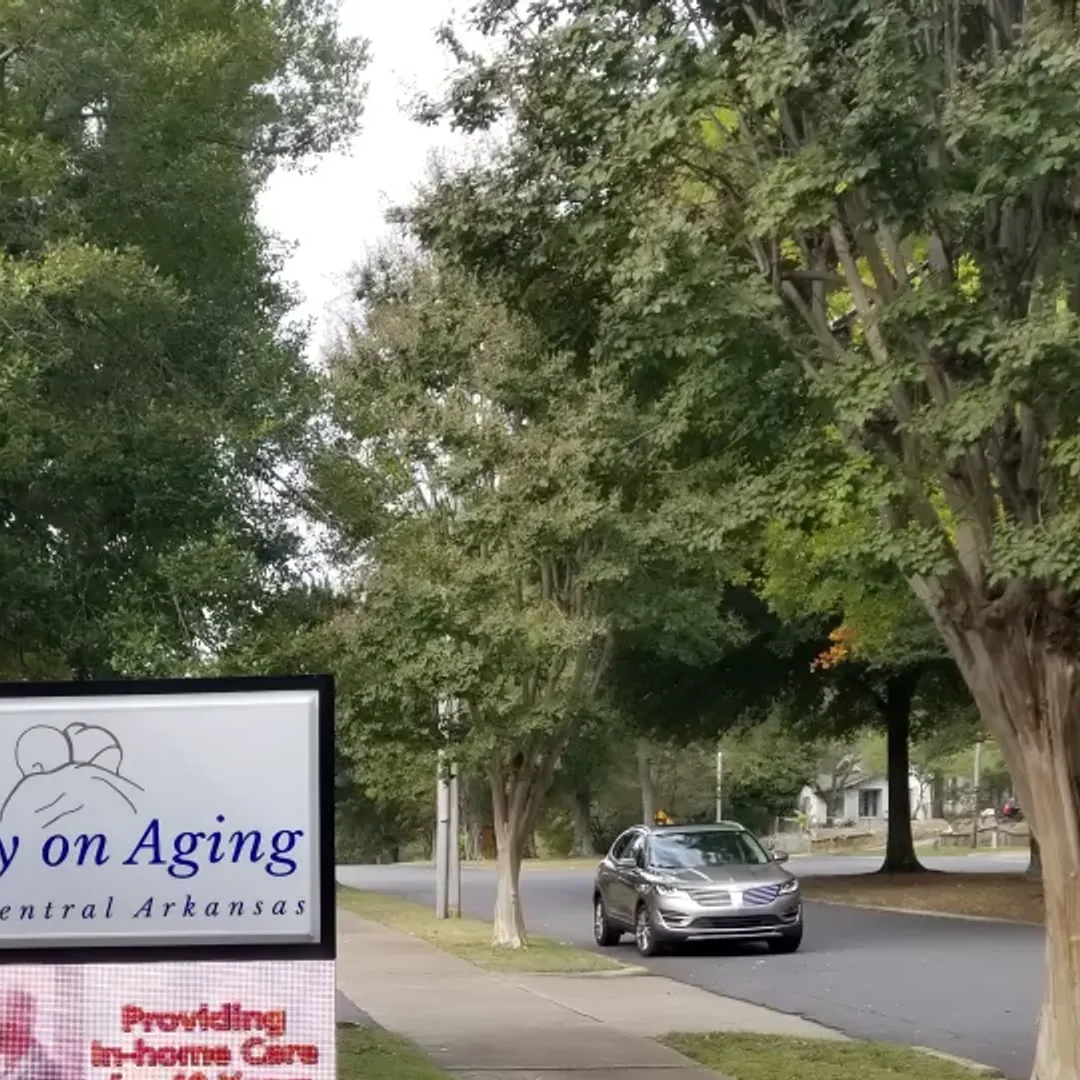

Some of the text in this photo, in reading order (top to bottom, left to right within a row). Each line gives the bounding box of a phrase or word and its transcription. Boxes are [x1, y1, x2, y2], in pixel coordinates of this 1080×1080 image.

[41, 833, 110, 868] on
[122, 814, 304, 880] Aging
[132, 895, 307, 919] Arkansas
[122, 1003, 286, 1037] Providing
[241, 1037, 318, 1066] Care
